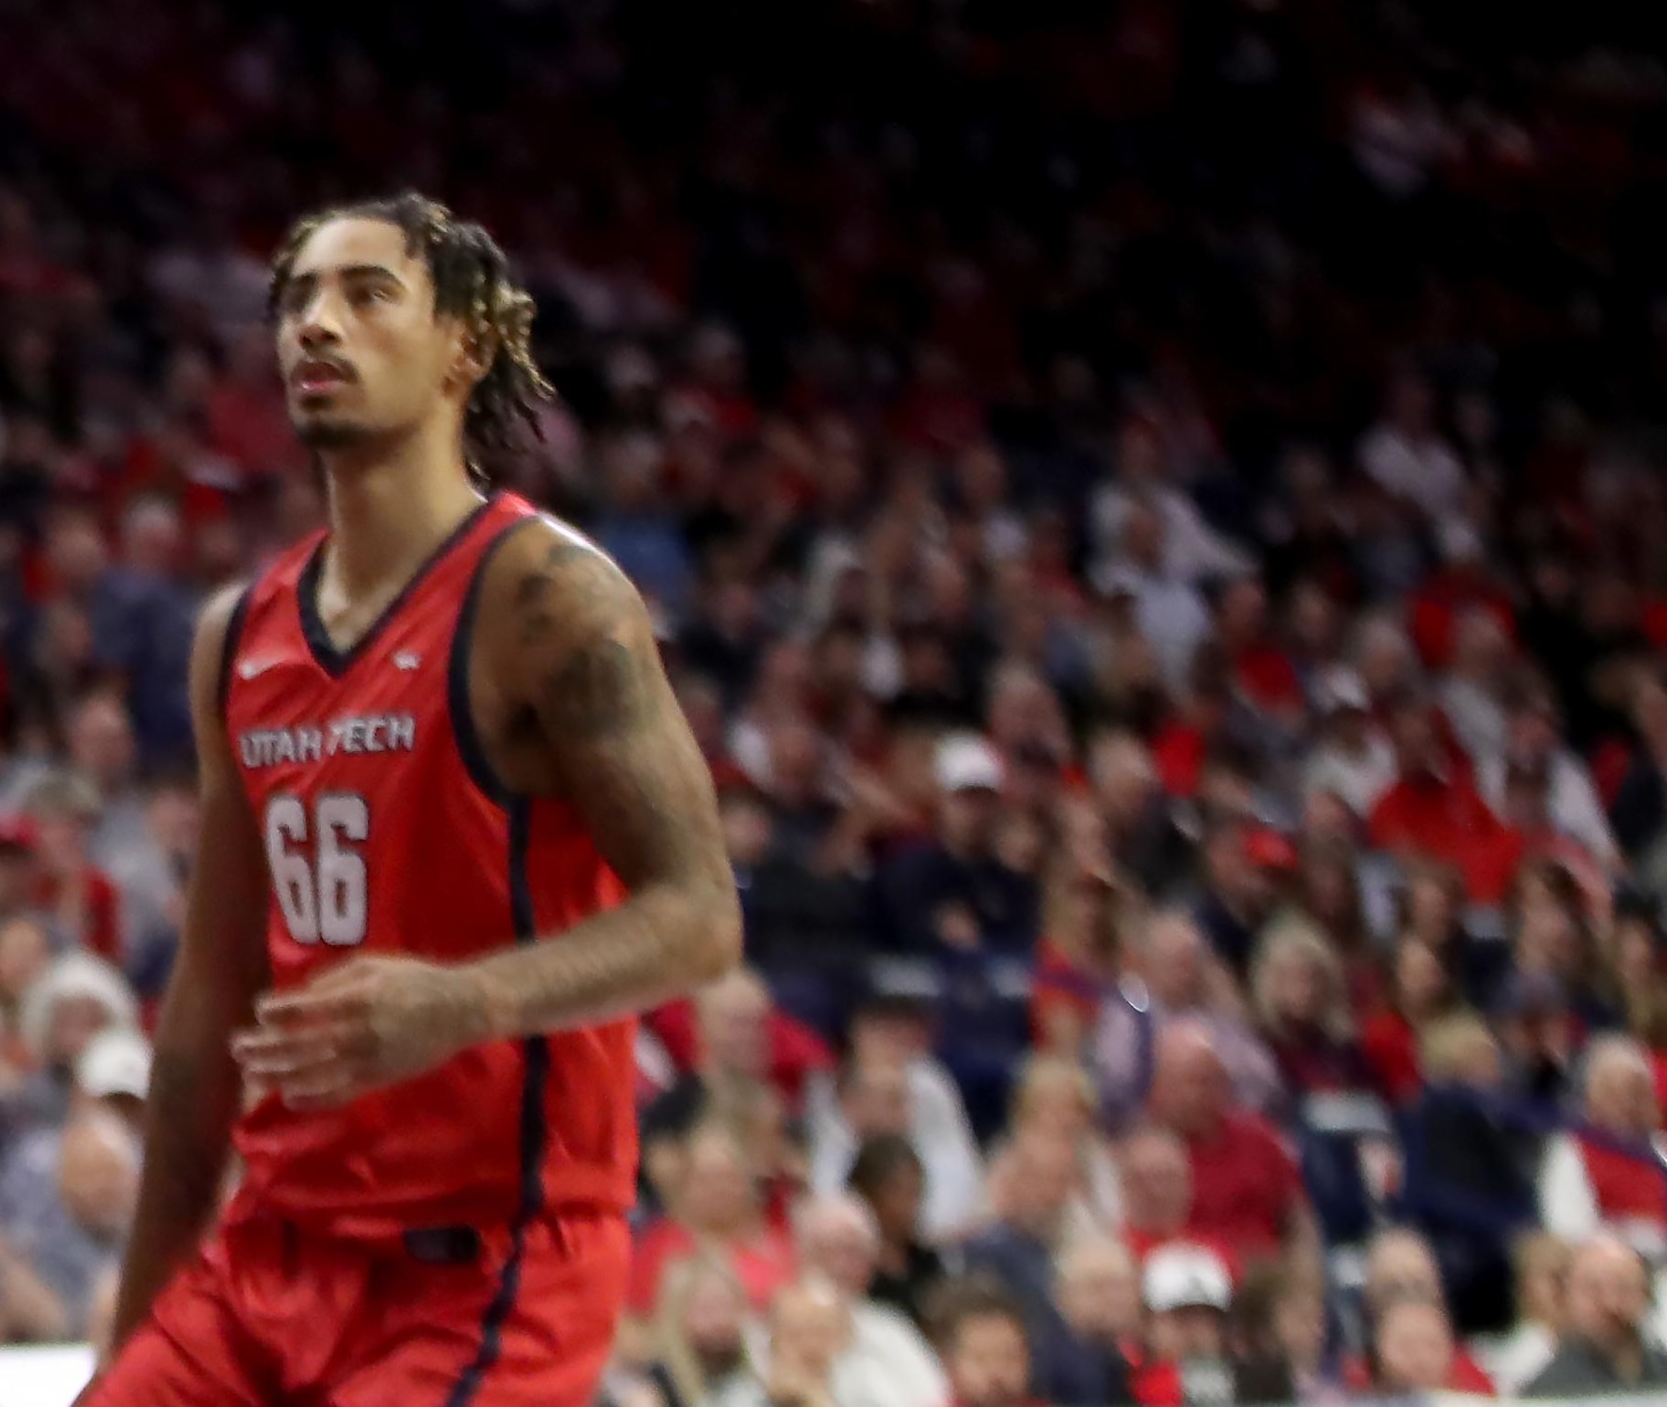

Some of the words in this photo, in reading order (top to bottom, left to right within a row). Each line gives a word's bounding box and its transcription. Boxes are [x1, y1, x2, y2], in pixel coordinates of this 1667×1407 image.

[241, 727, 322, 768] UTAH
[327, 714, 415, 755] TECH
[265, 792, 369, 947] 66
